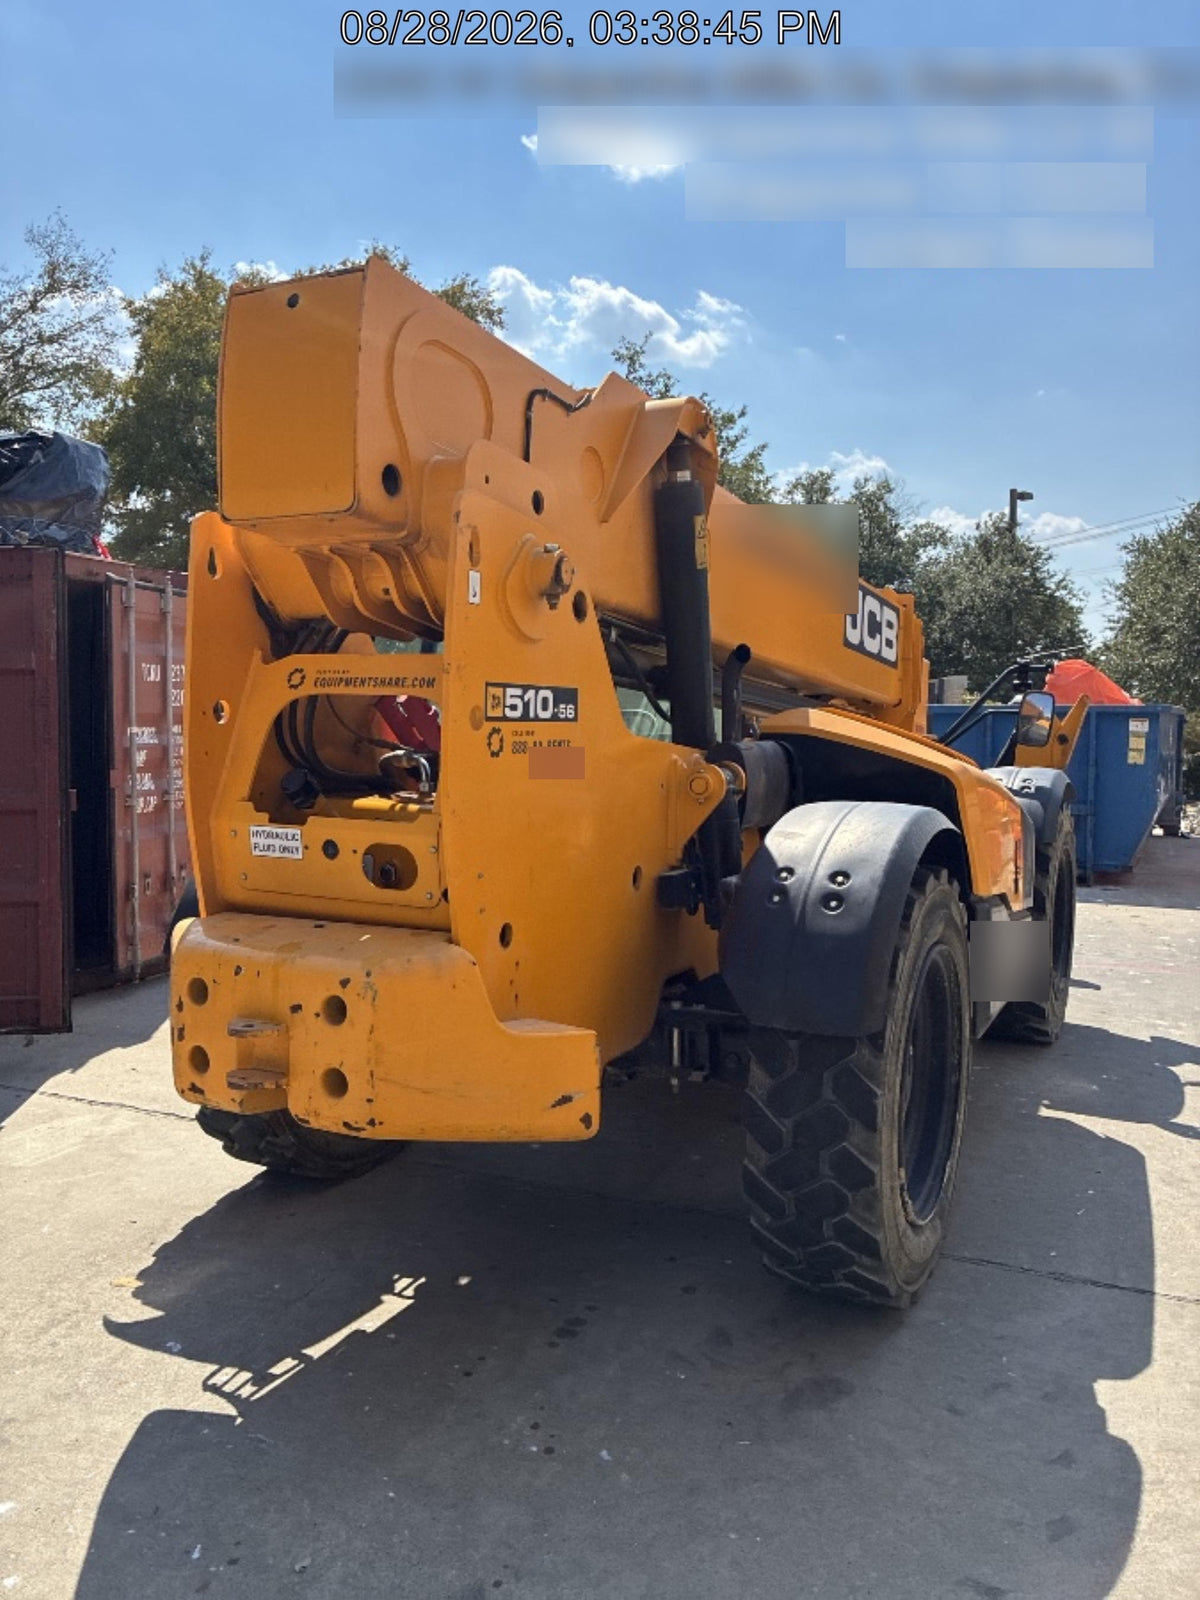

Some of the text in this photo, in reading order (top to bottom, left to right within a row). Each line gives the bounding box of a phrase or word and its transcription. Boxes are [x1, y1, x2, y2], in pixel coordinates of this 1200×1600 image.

[846, 590, 899, 663] JCB
[313, 676, 436, 689] EQUIPMENTSHARE.COM
[251, 829, 300, 842] HYDRAULIC
[253, 842, 300, 856] FLUID ONLY
